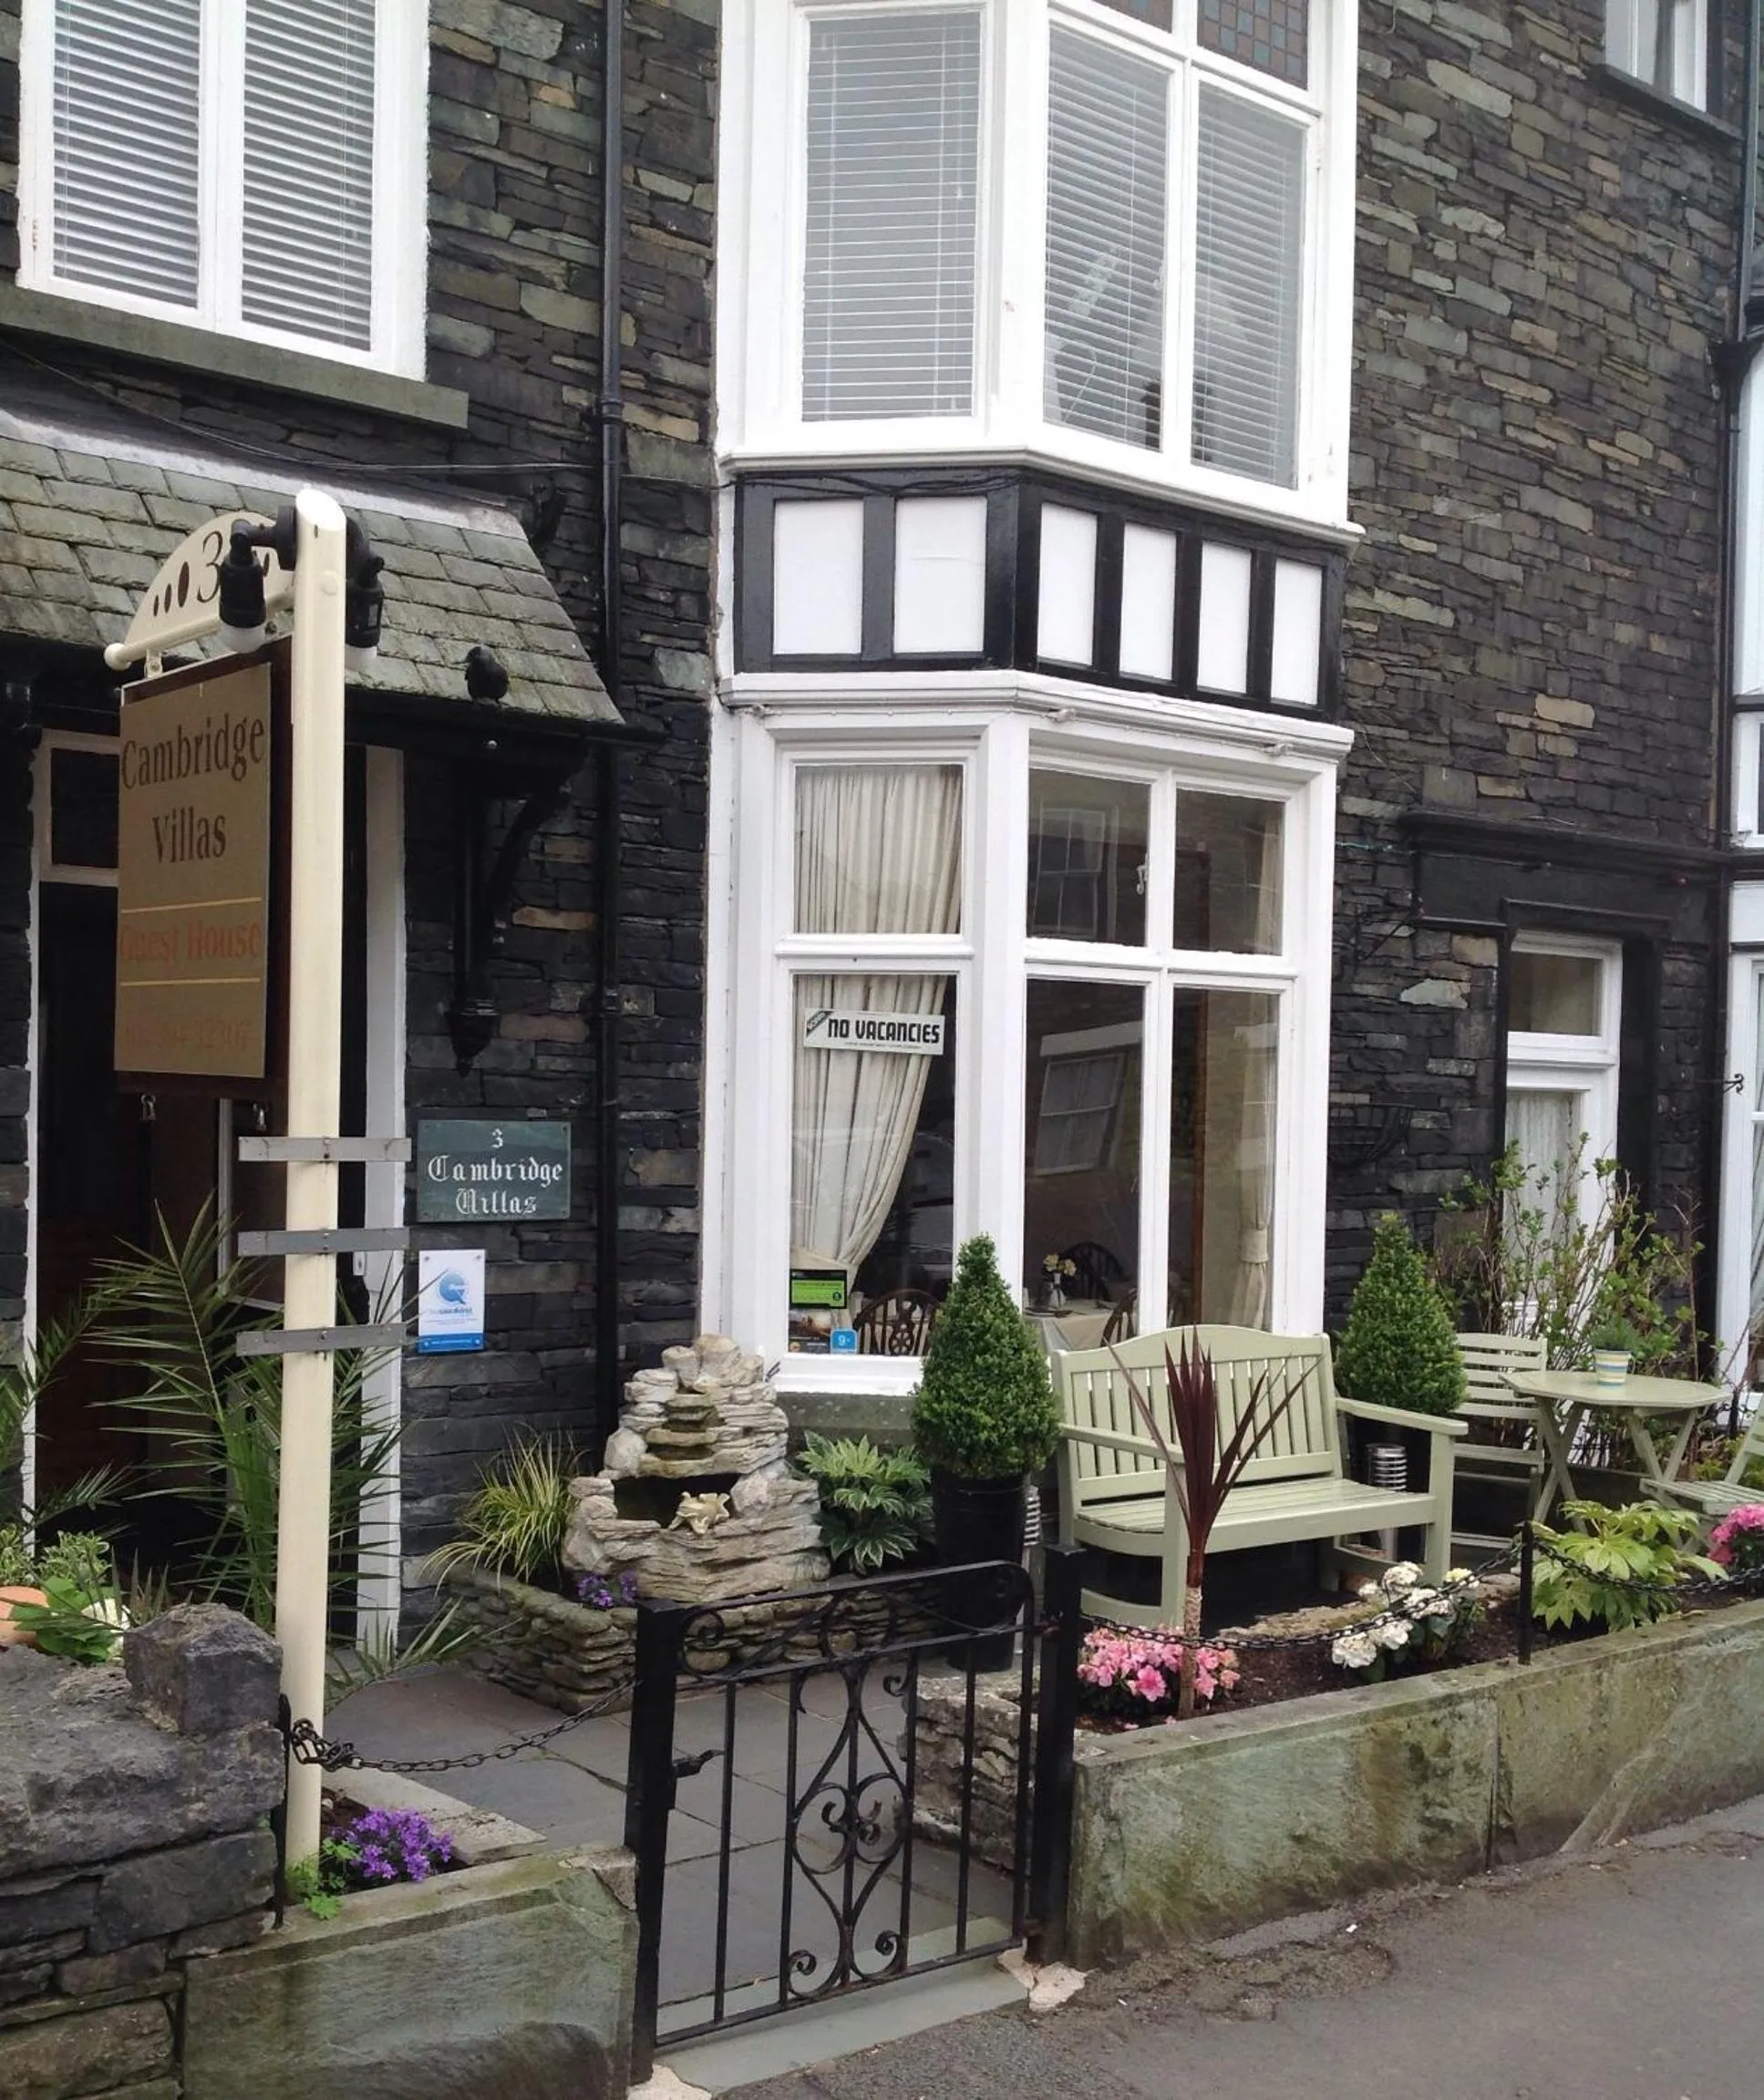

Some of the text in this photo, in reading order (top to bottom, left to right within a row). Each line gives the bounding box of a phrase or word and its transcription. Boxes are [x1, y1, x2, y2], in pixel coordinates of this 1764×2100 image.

[122, 713, 265, 790] Cambridge
[151, 806, 227, 864] Villas
[186, 919, 262, 961] House
[828, 1018, 850, 1038] NO
[855, 1020, 940, 1044] VACANCIES
[491, 1127, 504, 1148] 3
[428, 1154, 562, 1189] Cambridge
[456, 1188, 537, 1215] Villas
